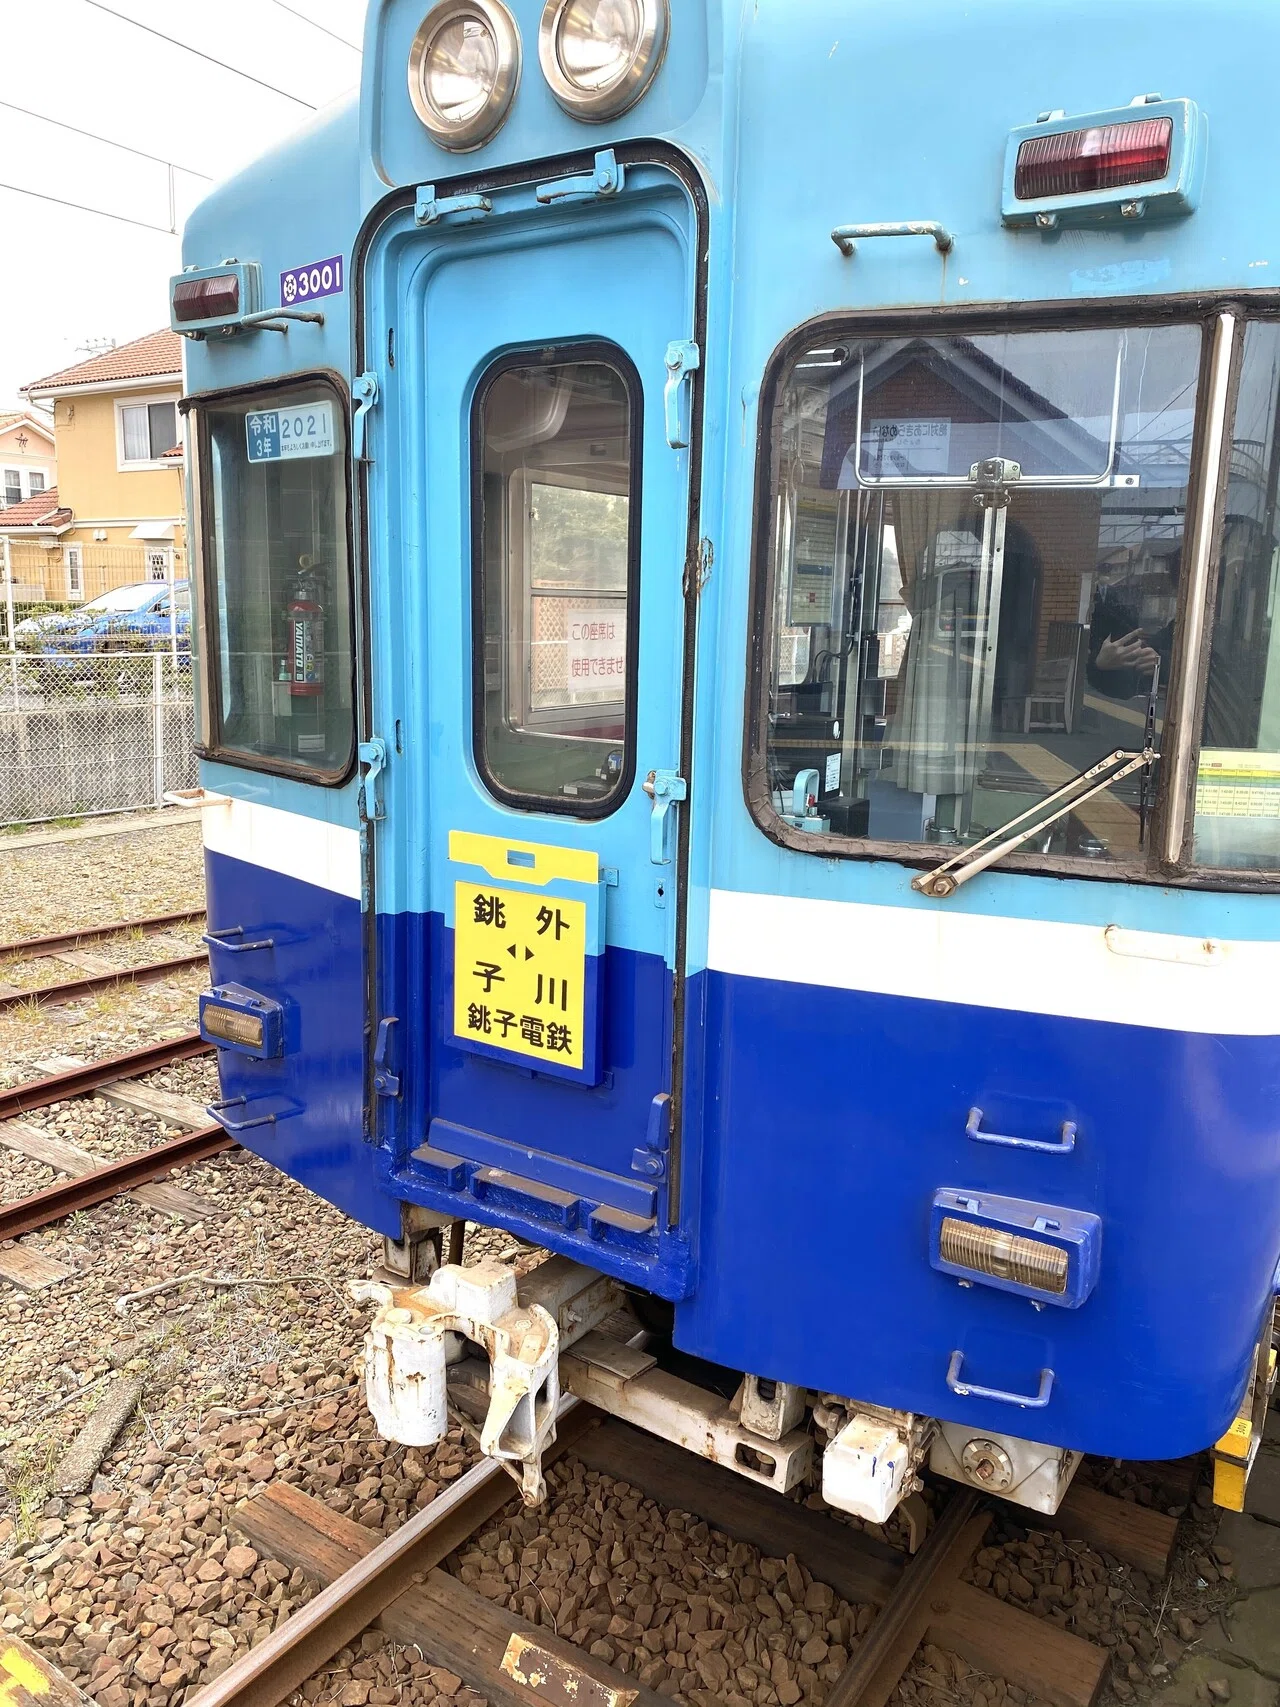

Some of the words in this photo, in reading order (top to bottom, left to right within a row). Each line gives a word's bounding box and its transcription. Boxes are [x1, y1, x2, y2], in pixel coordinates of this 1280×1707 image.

[298, 261, 340, 297] 3001
[249, 414, 277, 436] 令和
[281, 412, 327, 439] 2021
[256, 437, 273, 458] 3年
[572, 621, 616, 641] この座席は
[295, 622, 304, 668] YAMATO
[571, 656, 626, 678] 使用できませ
[467, 1002, 573, 1055] 銚子電鉄
